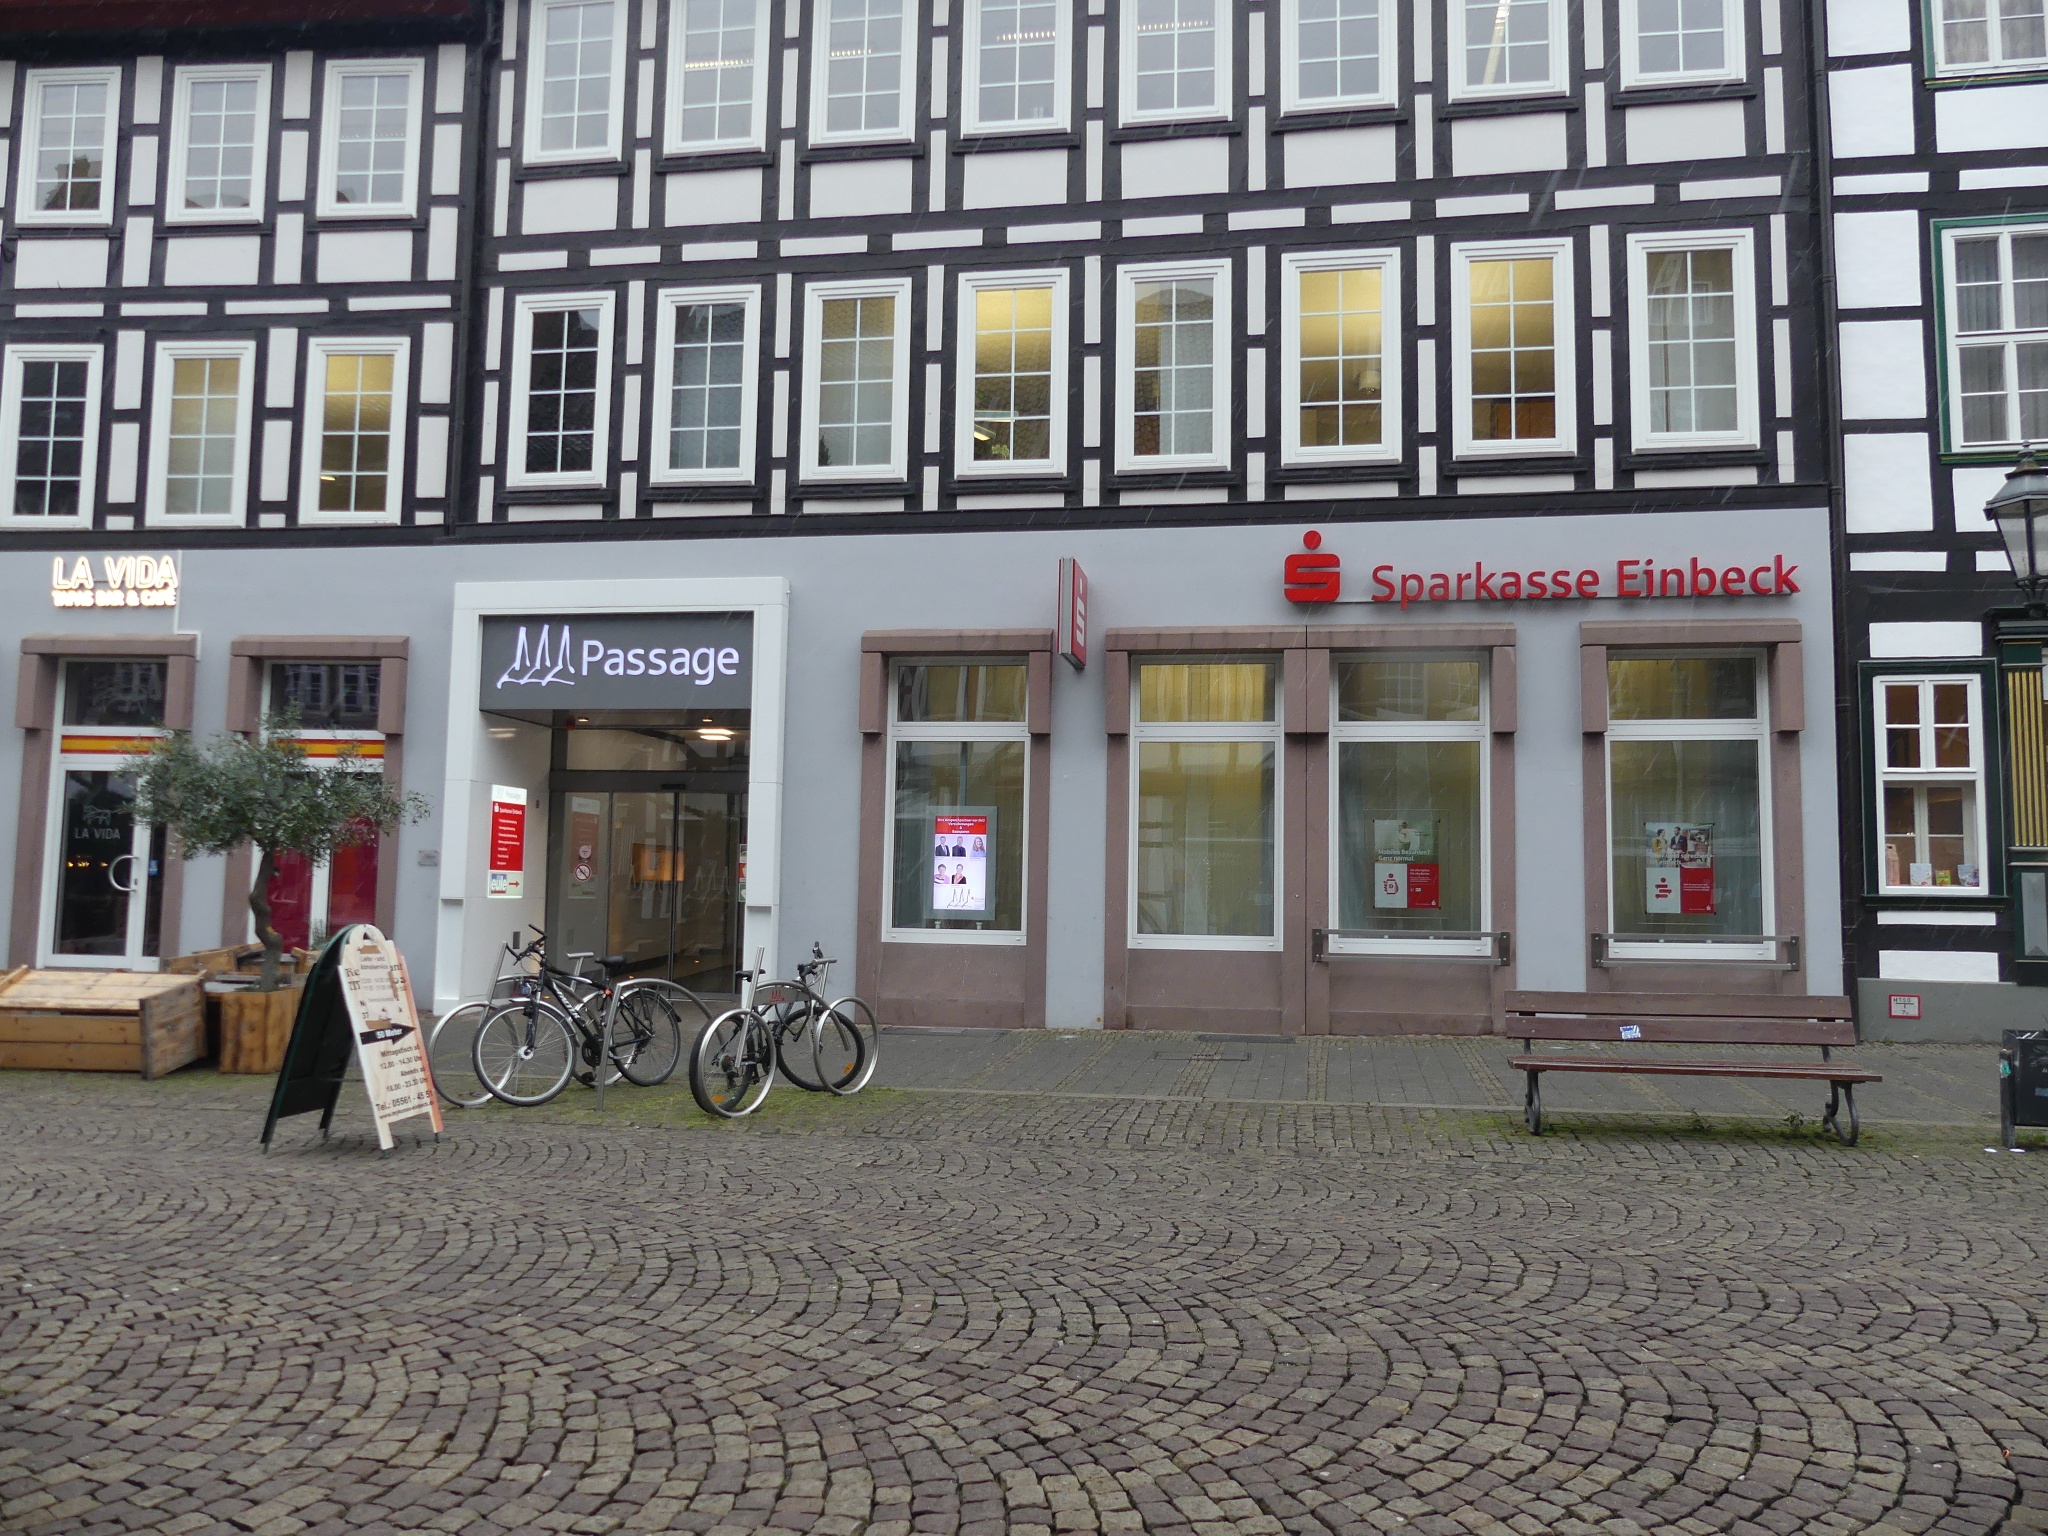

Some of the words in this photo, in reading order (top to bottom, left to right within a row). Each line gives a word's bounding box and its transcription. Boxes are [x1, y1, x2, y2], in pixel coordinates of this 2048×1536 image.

[53, 556, 94, 589] LA
[104, 556, 179, 589] VIDA
[1371, 561, 1600, 610] Sparkasse
[1616, 554, 1801, 598] Einbeck
[581, 640, 739, 686] Passage
[75, 828, 90, 839] LA
[94, 828, 121, 839] VIDA
[376, 1030, 385, 1039] 50
[386, 1028, 402, 1037] Meter
[381, 1045, 415, 1057] Mittagstisch
[401, 1067, 419, 1076] Abends
[376, 1103, 391, 1112] Tel.:
[392, 1096, 412, 1107] 05561
